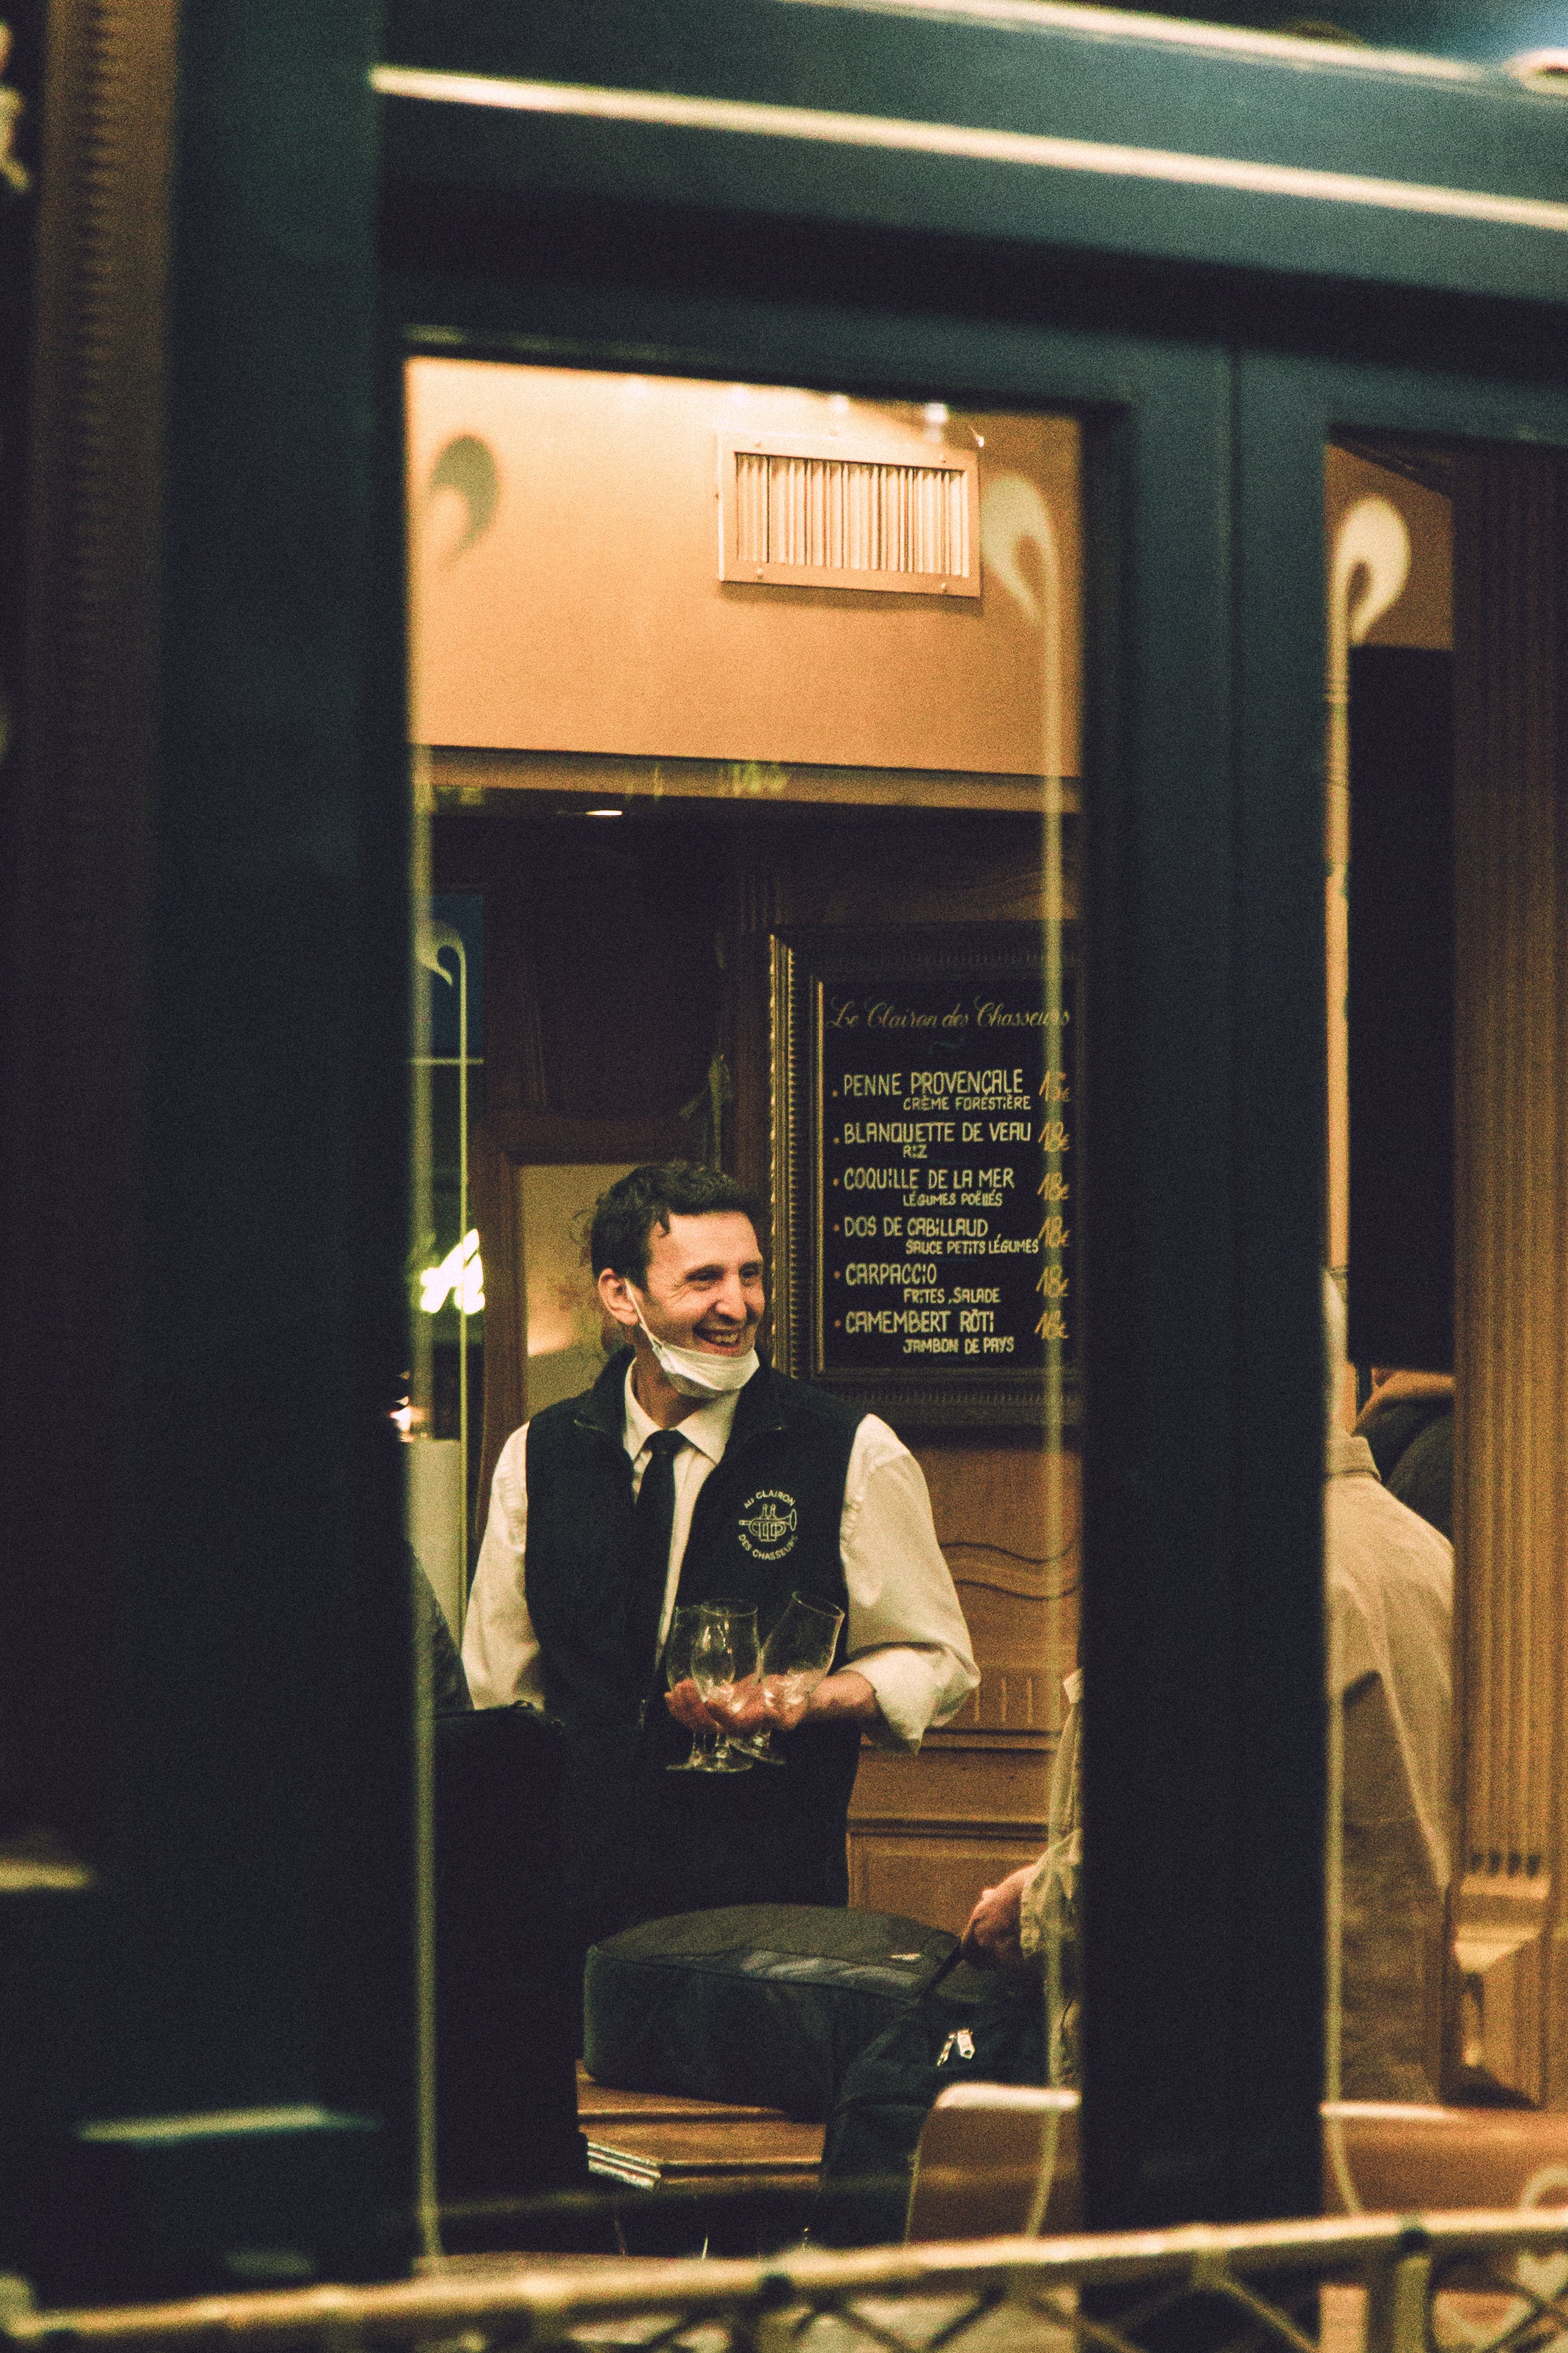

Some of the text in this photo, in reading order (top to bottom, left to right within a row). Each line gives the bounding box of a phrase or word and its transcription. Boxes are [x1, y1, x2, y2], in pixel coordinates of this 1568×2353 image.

[843, 1073, 902, 1096] PENNE
[911, 1068, 1023, 1096] PROVENÇALE
[844, 1121, 955, 1145] BLANQUETTE
[962, 1121, 984, 1143] DE
[989, 1121, 1032, 1142] VEAU
[928, 1168, 948, 1189] DE
[953, 1169, 972, 1189] LA
[979, 1167, 1015, 1191] MER
[844, 1215, 877, 1237] DOS
[883, 1216, 902, 1237] DE
[905, 1239, 943, 1255] SAUCE
[845, 1310, 951, 1333] CAMEMBERT
[964, 1337, 980, 1355] DE
[983, 1335, 1015, 1353] PAYS
[756, 1489, 795, 1507] CLAIRON
